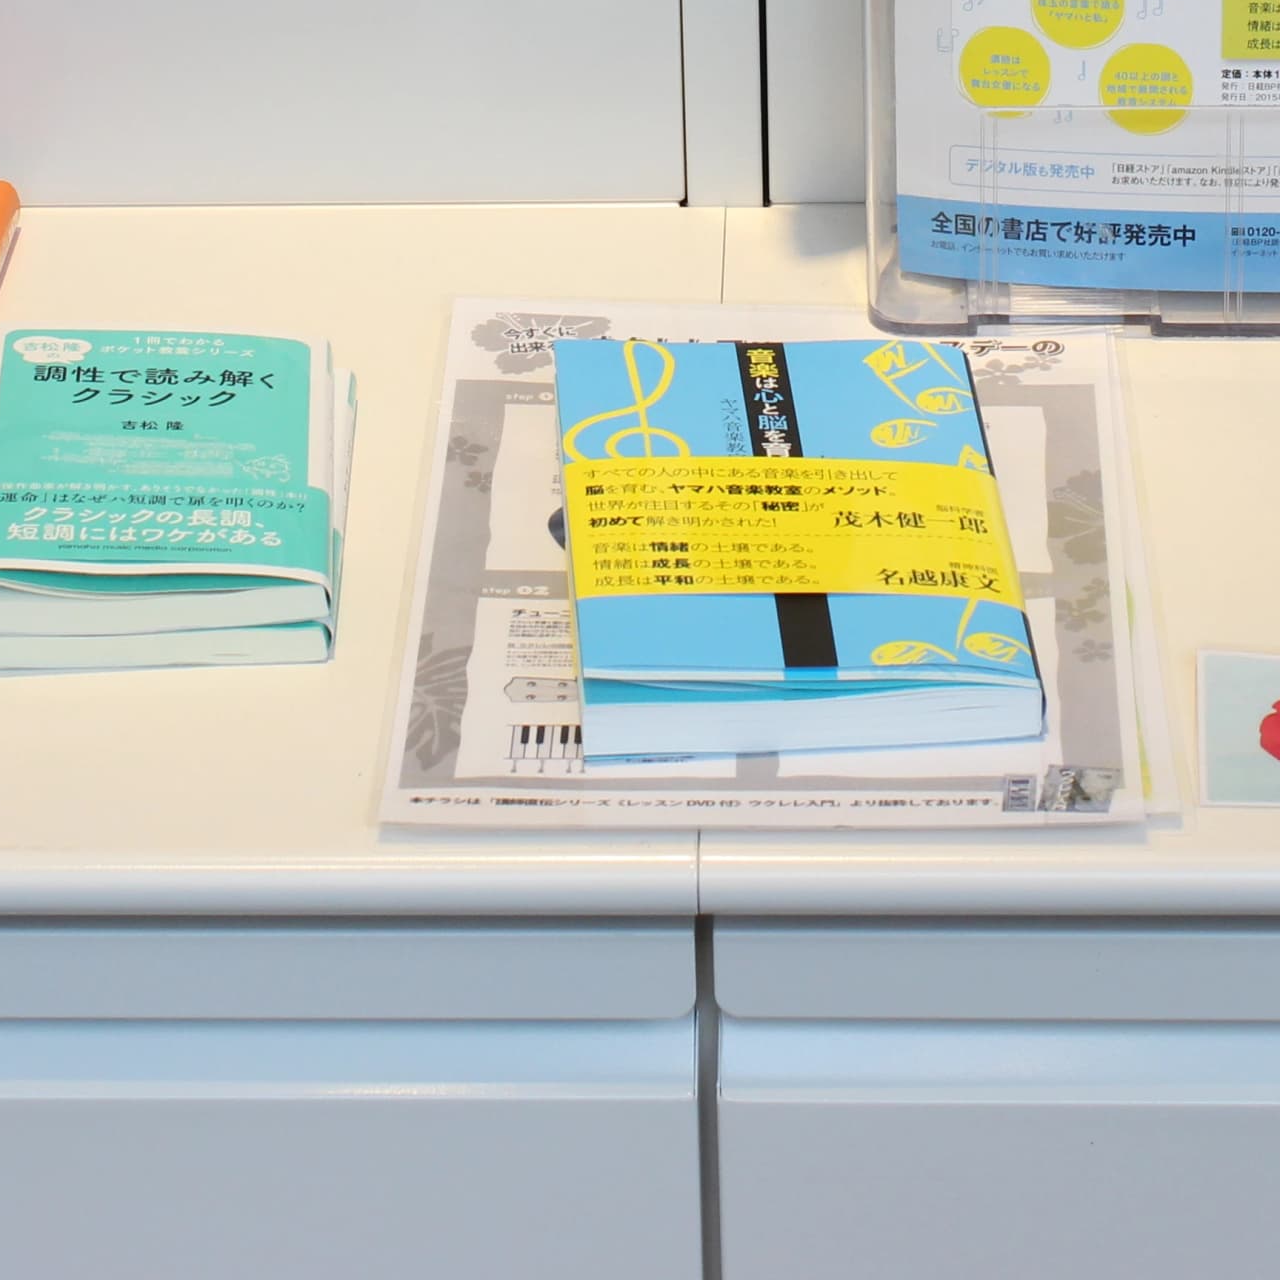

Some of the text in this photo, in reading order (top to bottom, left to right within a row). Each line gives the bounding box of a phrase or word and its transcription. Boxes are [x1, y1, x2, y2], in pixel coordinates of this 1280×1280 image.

[931, 211, 1196, 248] 全国の書店で好評発売中
[503, 326, 576, 340] 今すぐに
[33, 365, 276, 390] 調性で読み解く
[71, 387, 237, 407] クラシック
[121, 420, 159, 431] 吉松
[583, 466, 898, 482] すべての人の中にある音楽を引き出して
[23, 506, 265, 529] クラシックの長調、
[832, 508, 989, 535] 茂木健一郎
[6, 523, 283, 548] 短調にはワケがある
[592, 540, 816, 554] 音楽は情緒の土壌である。
[593, 556, 819, 571] 情緒は成長の土壌である。
[594, 573, 821, 587] 成長は平和の土壌である。
[876, 567, 1002, 594] 名越康文
